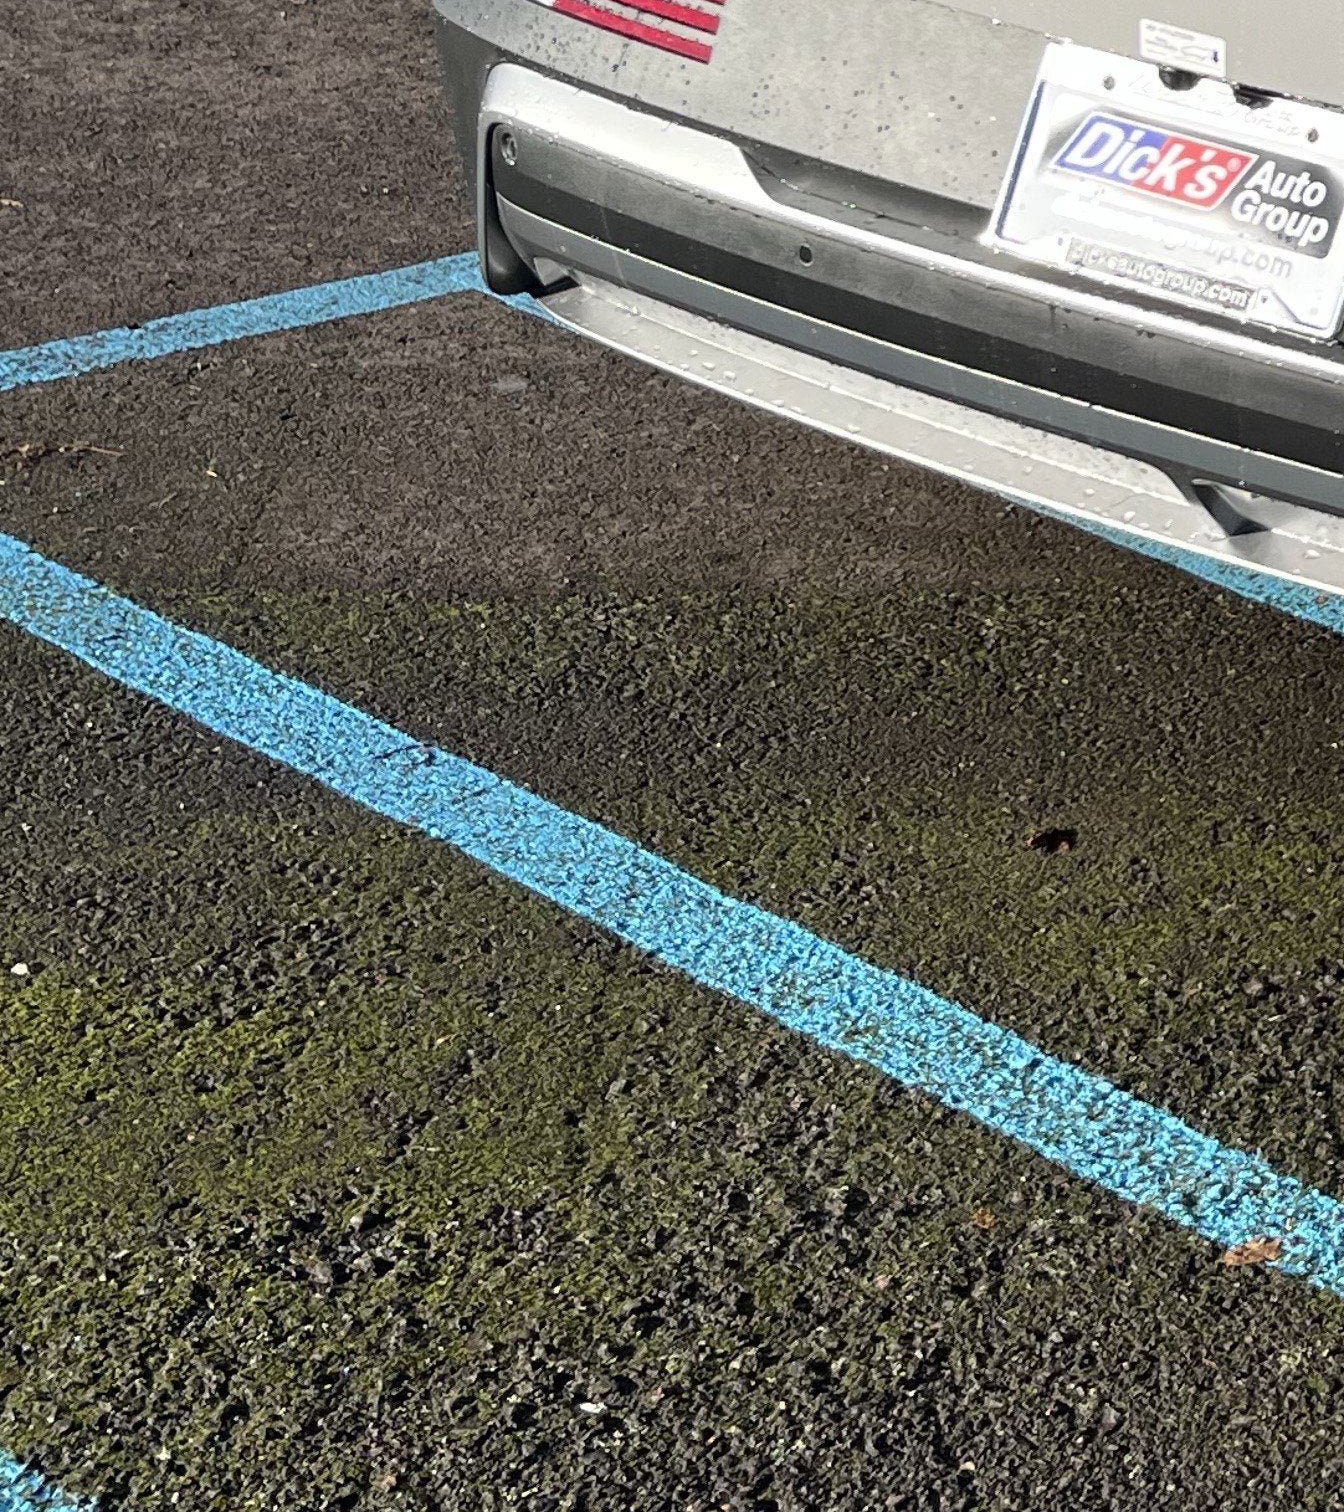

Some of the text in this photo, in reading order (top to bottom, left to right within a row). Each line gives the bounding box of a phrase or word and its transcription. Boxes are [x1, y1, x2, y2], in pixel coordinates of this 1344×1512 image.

[1063, 119, 1228, 200] Dick's
[1244, 159, 1327, 208] Auto
[1230, 187, 1329, 247] Group
